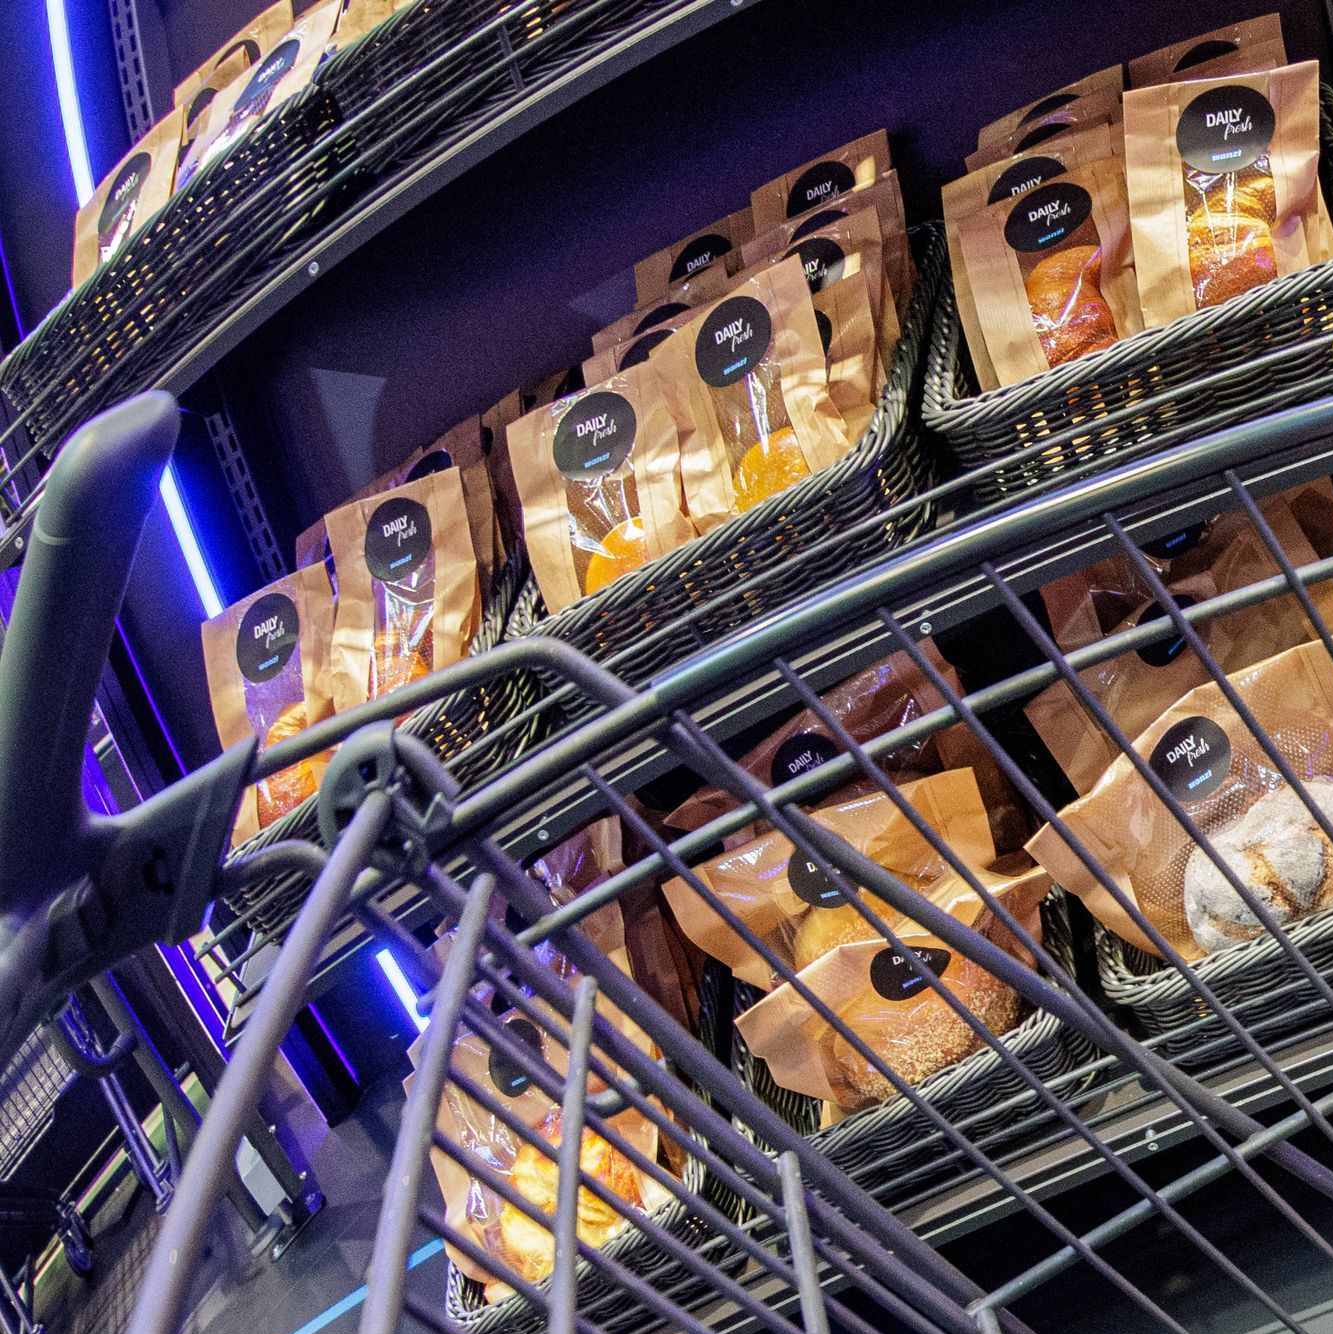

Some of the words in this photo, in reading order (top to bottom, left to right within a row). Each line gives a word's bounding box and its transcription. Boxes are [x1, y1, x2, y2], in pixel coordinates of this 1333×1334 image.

[1206, 108, 1242, 127] DAILY
[1224, 115, 1252, 141] fresh
[806, 180, 833, 201] DAILY
[1028, 200, 1060, 222] DAILY
[1046, 201, 1071, 226] fresh
[686, 251, 711, 273] DAILY
[714, 318, 743, 345] DAILY
[731, 326, 753, 352] fresh
[575, 413, 608, 437] DAILY
[592, 418, 617, 446] fresh
[382, 515, 408, 537] DAILY
[253, 615, 278, 640] DAILY
[1165, 734, 1198, 764] DAILY
[1187, 738, 1211, 767] fresh
[787, 750, 814, 775] DAILY
